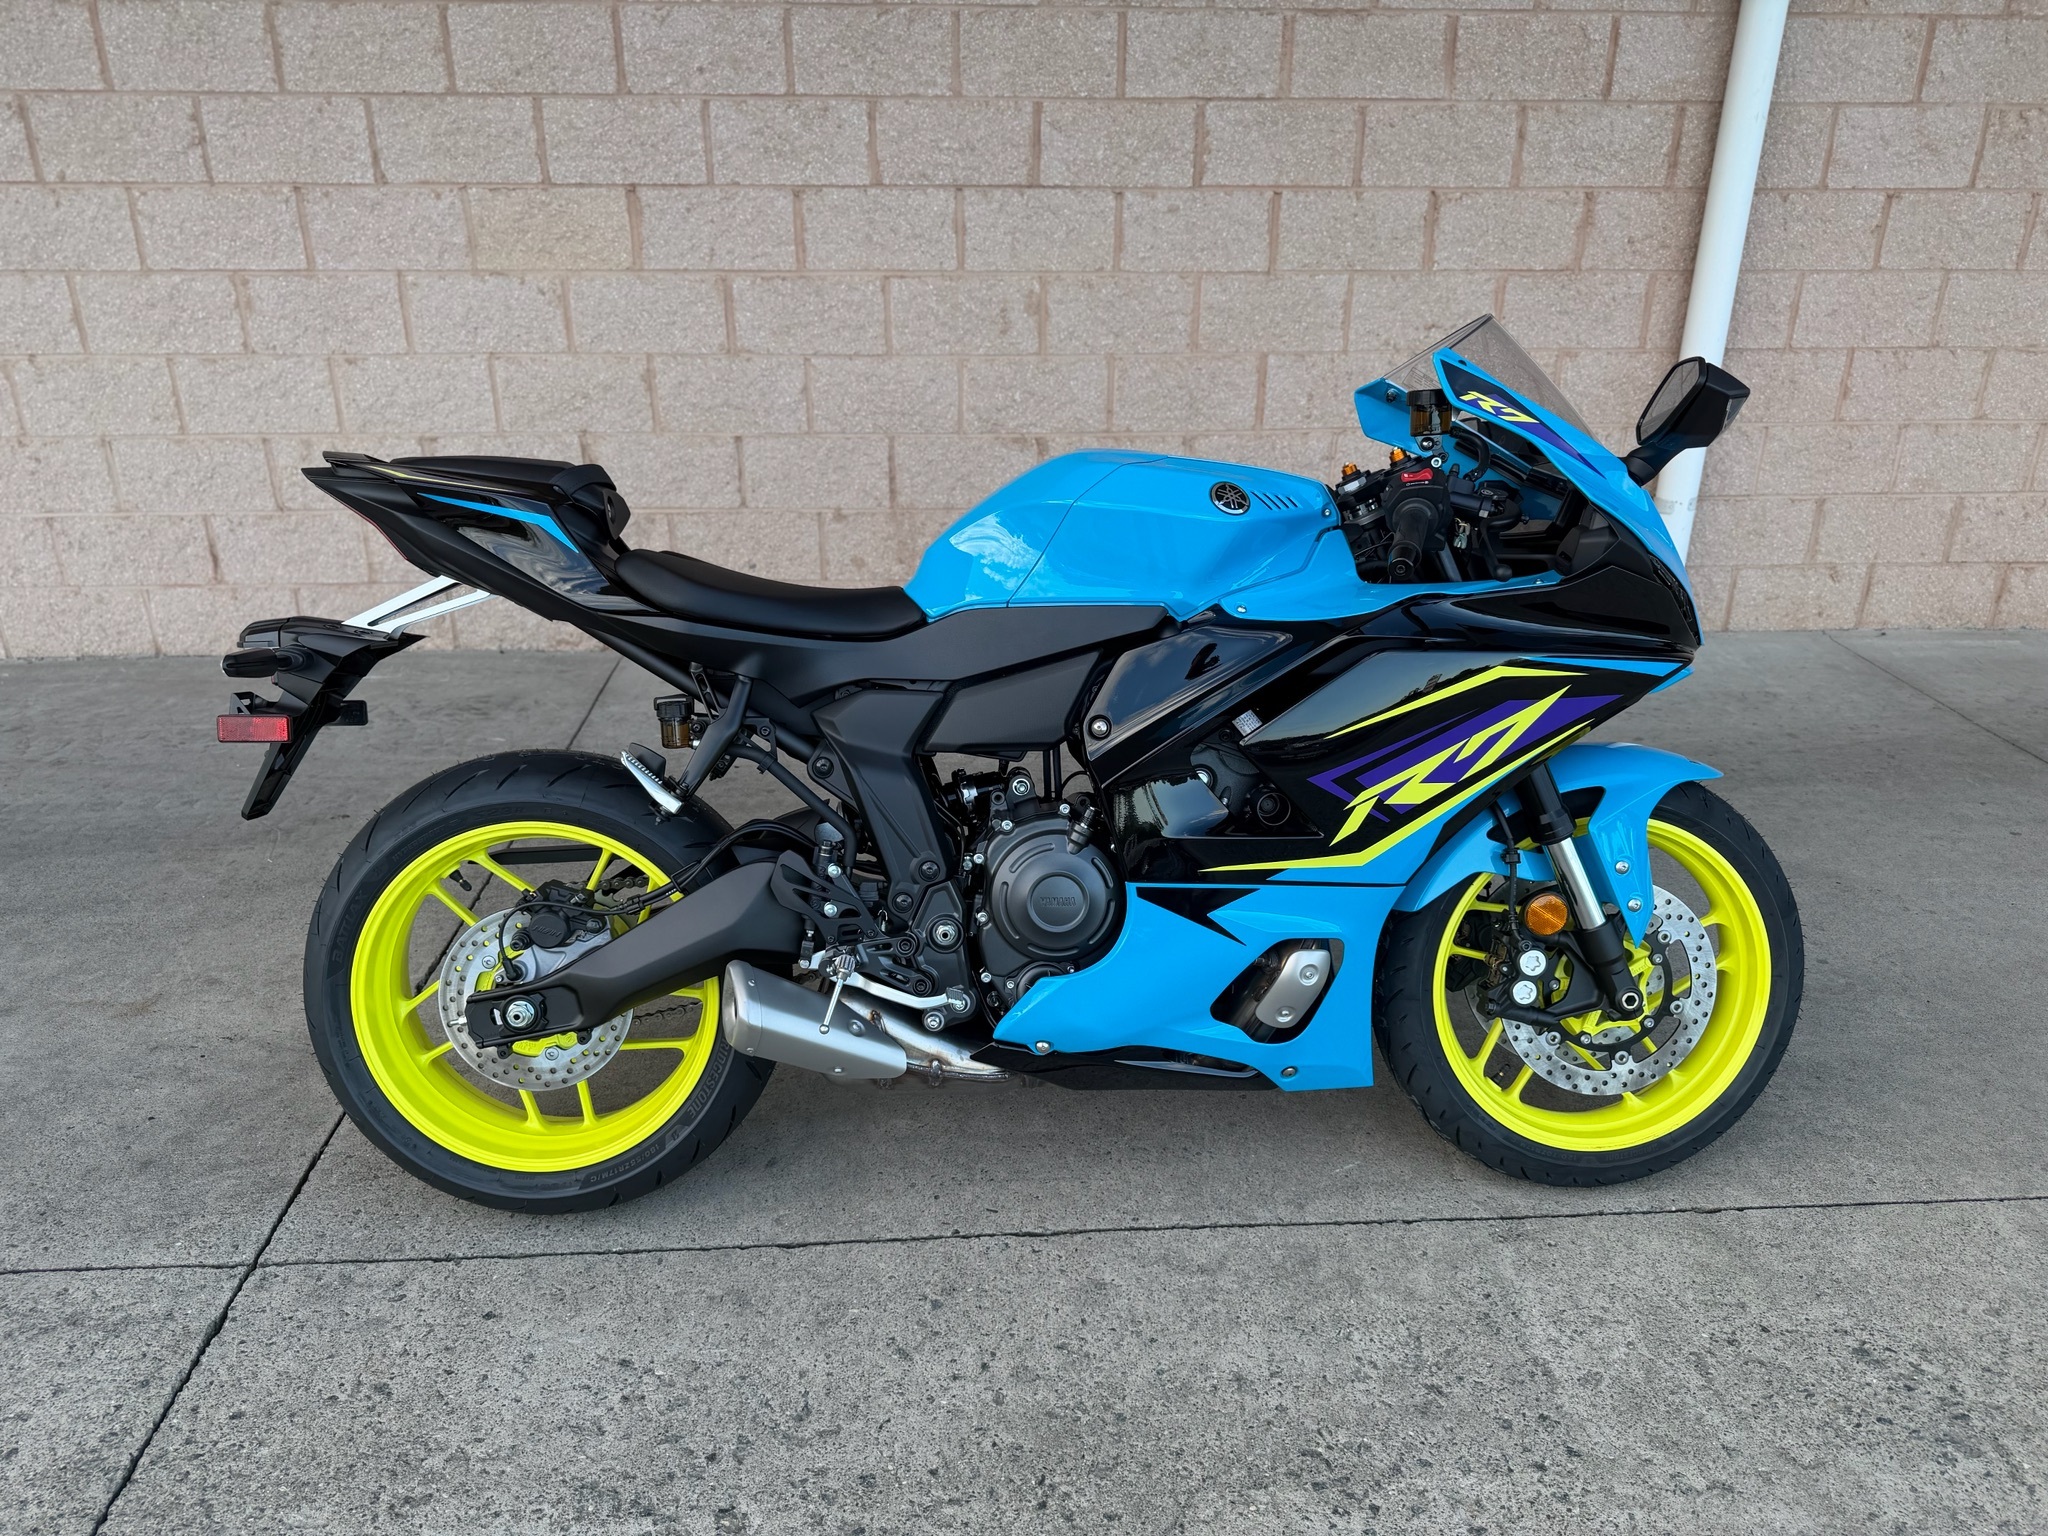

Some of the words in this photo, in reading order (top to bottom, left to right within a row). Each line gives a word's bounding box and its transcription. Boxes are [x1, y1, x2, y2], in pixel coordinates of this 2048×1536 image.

[1459, 391, 1540, 423] R7
[1329, 684, 1572, 847] R7
[687, 1037, 731, 1119] RIDGESTONE
